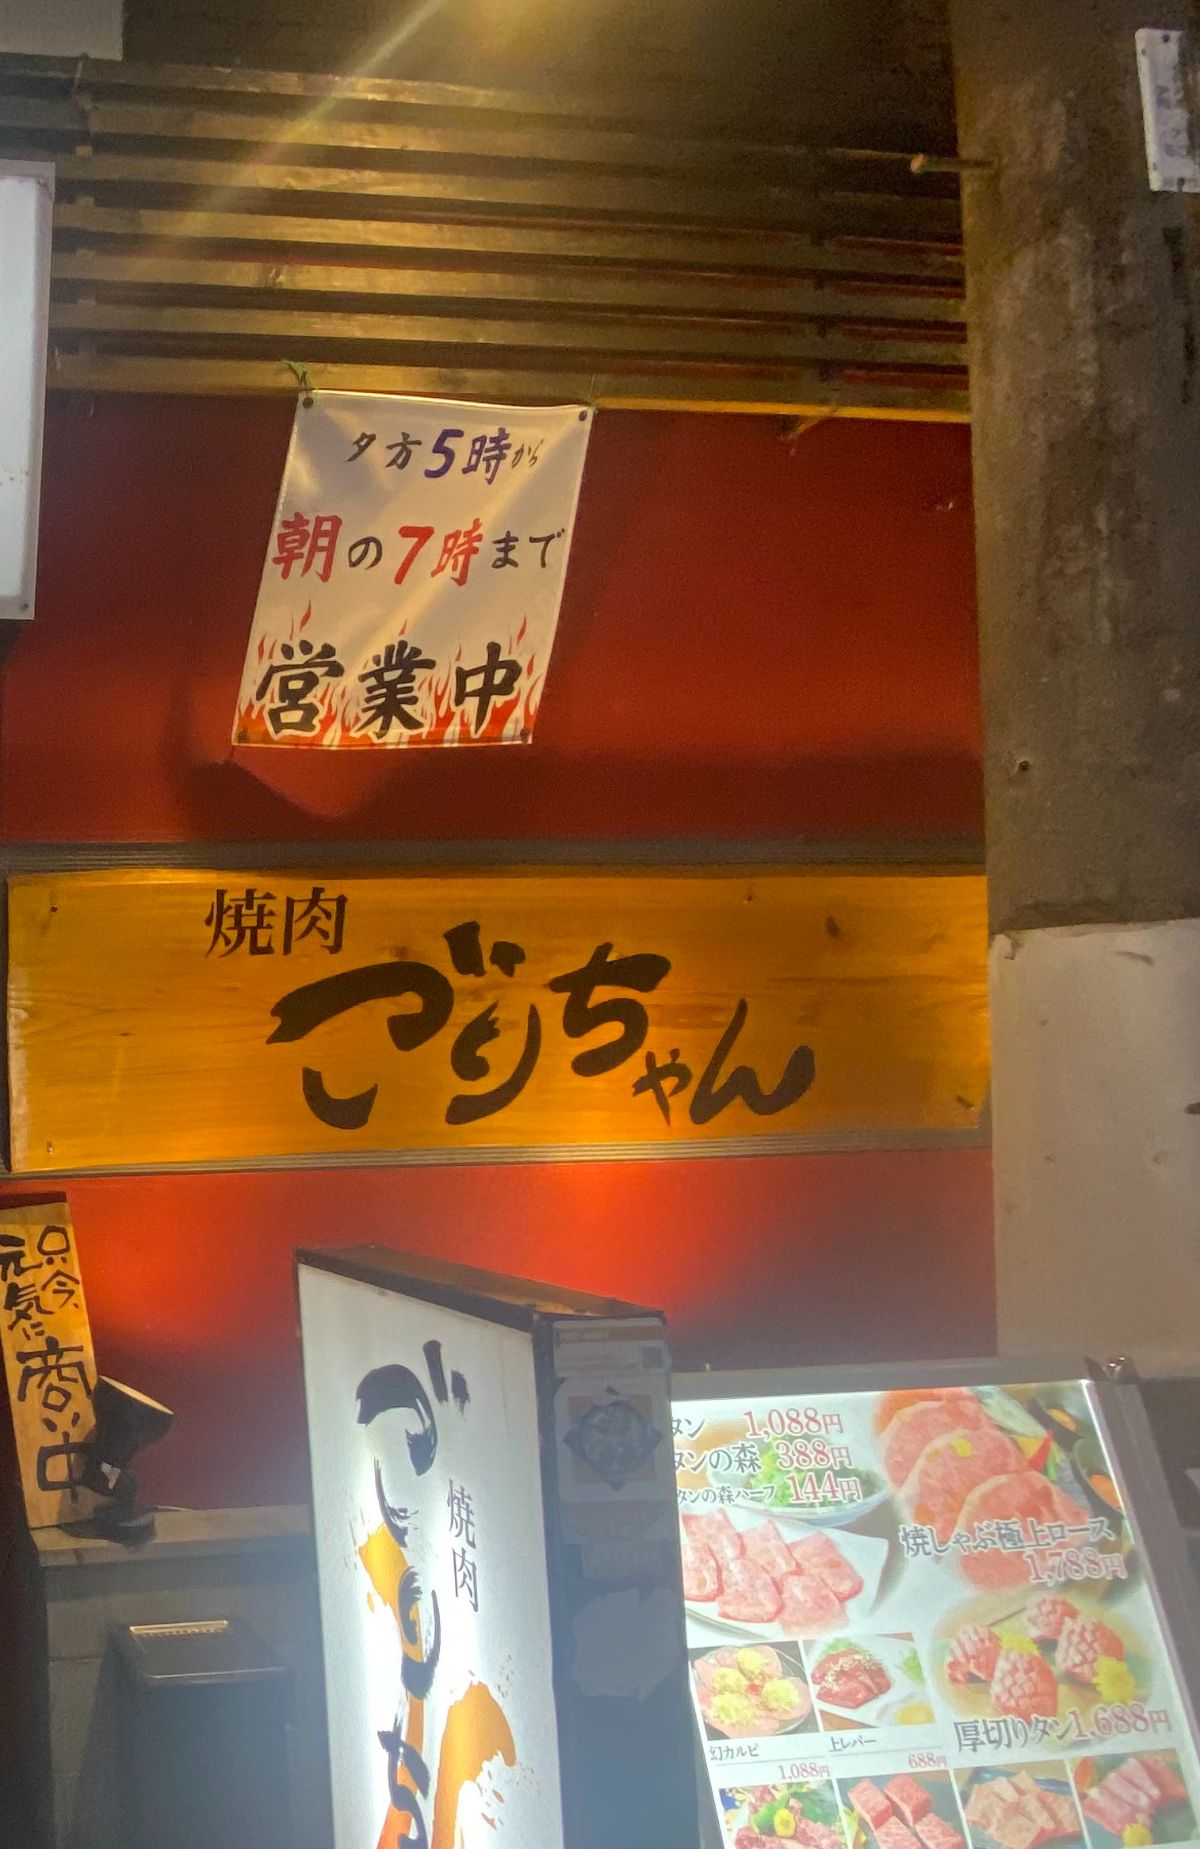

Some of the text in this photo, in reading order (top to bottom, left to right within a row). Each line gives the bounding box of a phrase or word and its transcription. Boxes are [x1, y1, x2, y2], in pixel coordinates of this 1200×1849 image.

[346, 427, 544, 485] 夕方5時から
[272, 511, 565, 587] 朝の7時まで
[256, 639, 522, 739] 営業中
[205, 887, 348, 958] 焼肉
[266, 920, 816, 1129] ごりちゃん
[744, 1407, 844, 1442] 1,088円
[775, 1440, 852, 1469] 388円
[787, 1472, 862, 1503] 144円
[446, 1478, 478, 1613] 焼肉
[901, 1518, 1115, 1558] 焼しゃぶ極上ロース
[1024, 1548, 1127, 1586] 1,788円
[954, 1712, 1071, 1753] 厚切りタン
[778, 1753, 946, 1780] 1,088円 688円
